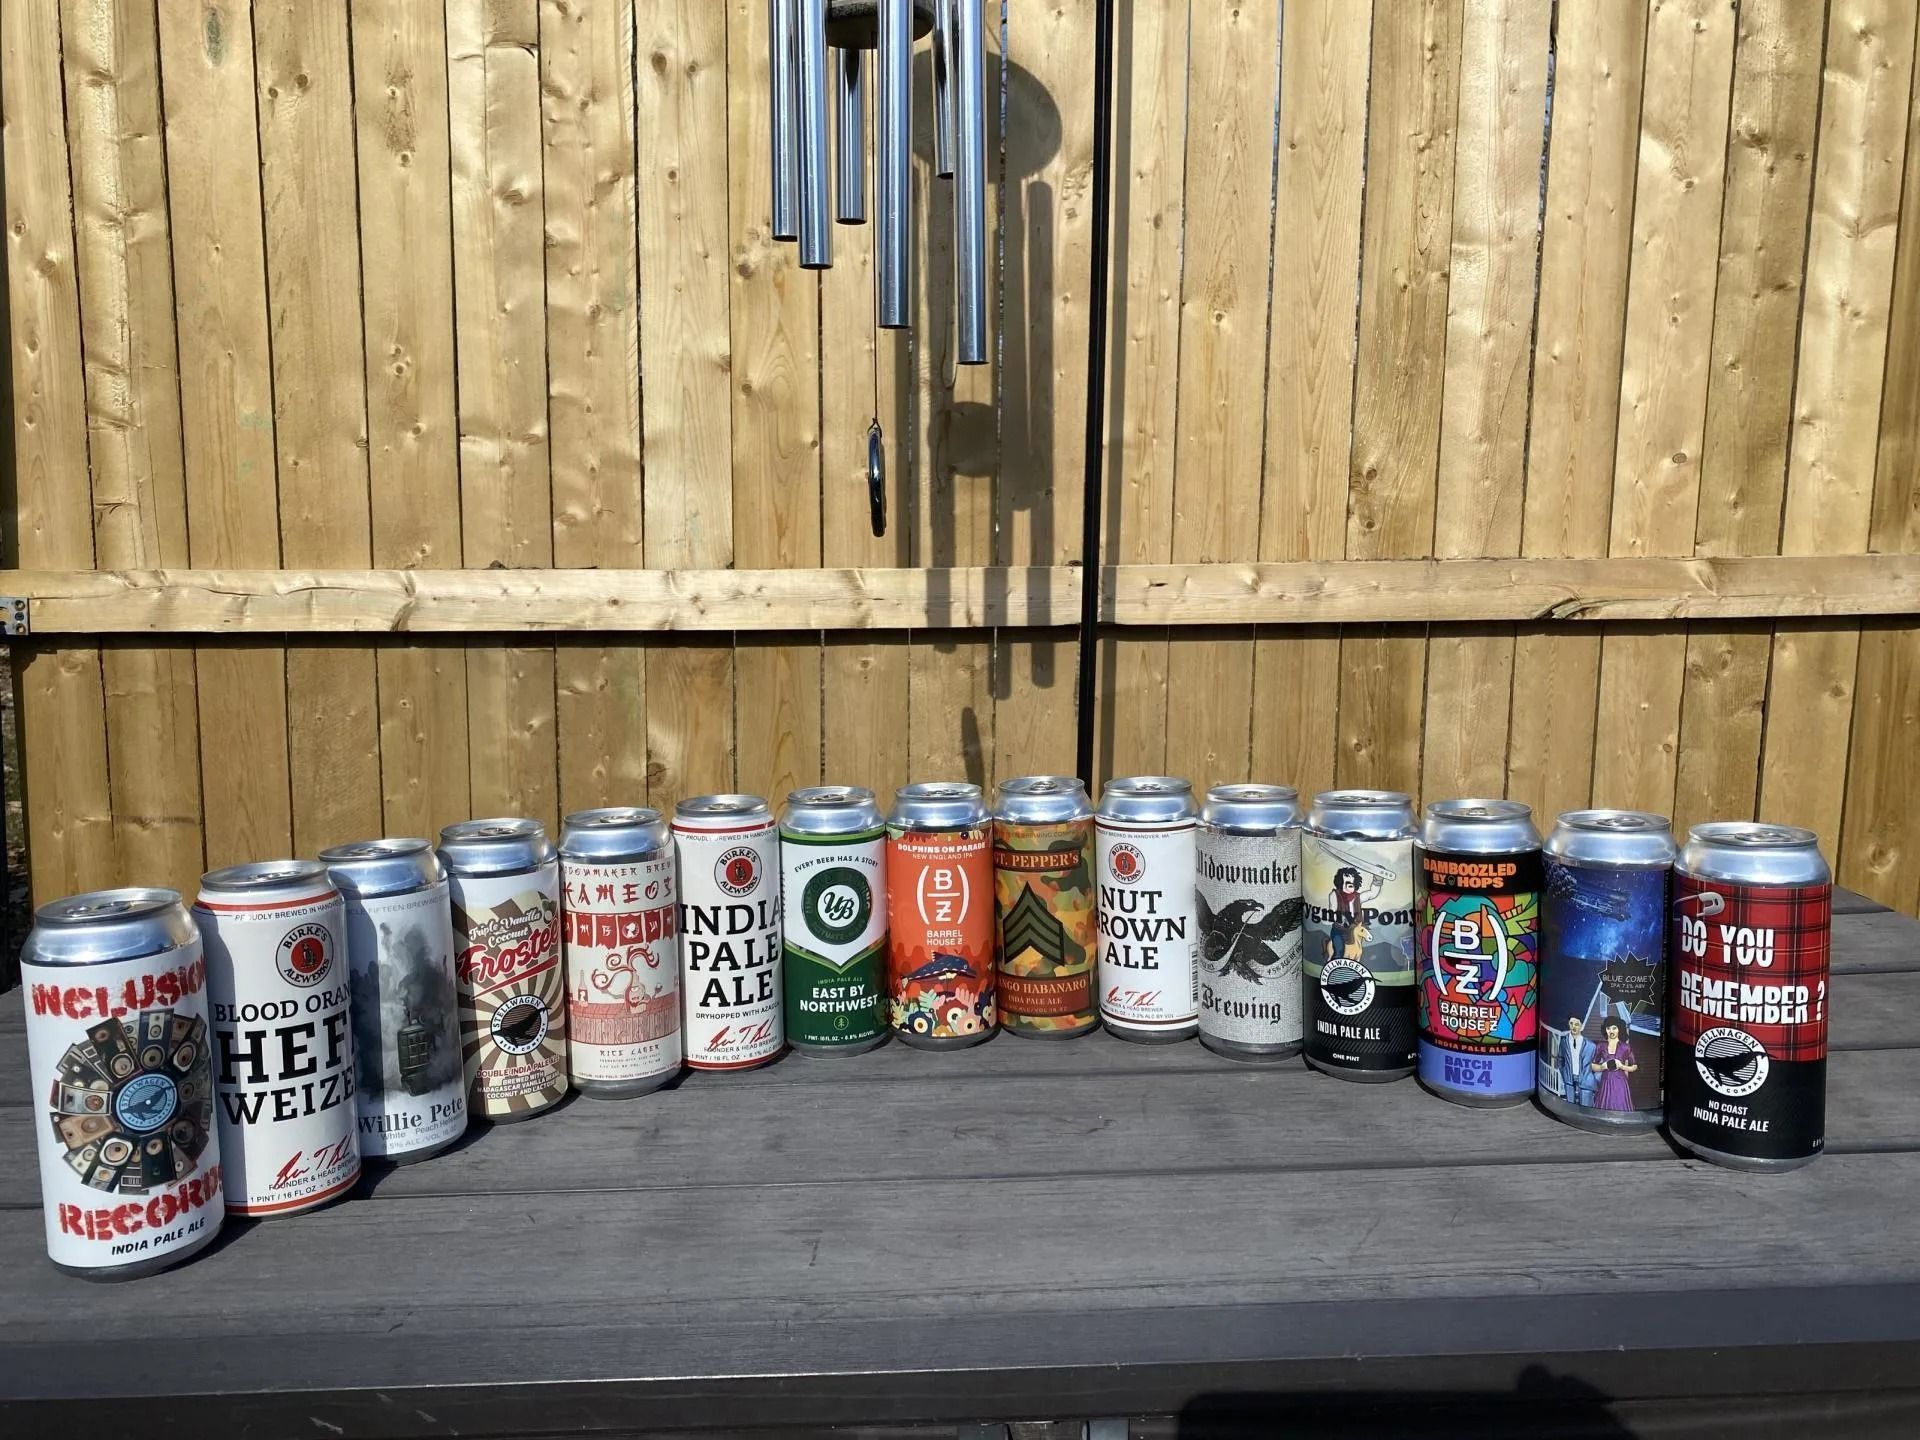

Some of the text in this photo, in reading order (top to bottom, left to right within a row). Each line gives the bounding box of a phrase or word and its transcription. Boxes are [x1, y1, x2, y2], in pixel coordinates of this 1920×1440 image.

[897, 843, 940, 854] DOLPHINS
[957, 842, 986, 852] PARADE
[1112, 844, 1140, 859] BURKE'S
[719, 849, 757, 866] BURKE'S
[794, 860, 814, 872] EVERY
[816, 856, 835, 865] BEER
[1423, 858, 1517, 877] BAMBOOZLED
[720, 875, 758, 894] ALEWERKS
[1433, 873, 1504, 888] BY HOPS
[1101, 884, 1162, 914] NUT
[275, 906, 316, 918] BREWED IN
[680, 894, 781, 935] INDIA
[468, 907, 542, 940] Triple Vanilla
[282, 926, 328, 950] BURKE'S
[488, 927, 529, 948] Coconut
[927, 930, 963, 938] BARREL
[927, 938, 956, 946] HOUSE
[1681, 915, 1774, 967] DO YOU
[688, 931, 779, 971] PALE
[1105, 942, 1159, 970] ALE
[284, 958, 330, 983] ALEWERKS
[1321, 960, 1366, 983] STELLWAGEN
[1602, 974, 1653, 983] BLUE COMET
[699, 969, 773, 1008] ALE
[812, 984, 865, 999] EAST BY
[1023, 978, 1086, 994] HABANARO
[800, 994, 878, 1013] NORTHWEST
[1026, 997, 1045, 1005] PALE
[1202, 983, 1281, 1026] Brewing
[1326, 992, 1372, 1013] BEER COMPANY
[1680, 970, 1809, 1024] REMEMBER
[214, 1000, 298, 1023] BLOOD
[493, 997, 541, 1028] STELLWAGEN
[695, 1008, 760, 1020] DRYHOPPED WITH
[1441, 1002, 1498, 1018] BARREL
[1317, 1020, 1381, 1040] INDIA PALE ALE
[1441, 1015, 1485, 1031] HOUSE
[631, 1044, 659, 1055] LAGER
[1434, 1039, 1458, 1050] INDIA
[1461, 1043, 1486, 1053] PALE
[1697, 1028, 1759, 1055] STELLWAGEN
[476, 1060, 549, 1078] DOUBLE INDIA PALE
[1444, 1055, 1493, 1070] BATCH
[522, 1077, 546, 1088] VANILLA
[1702, 1069, 1764, 1094] BEER COMPANY
[486, 1091, 518, 1099] COCONUT
[358, 1112, 422, 1134] Willie
[430, 1097, 463, 1123] Pete
[1708, 1099, 1748, 1116] NO COAST
[1693, 1107, 1770, 1132] INDIA PALE ALE
[380, 1124, 438, 1141] White Peach
[318, 1167, 336, 1178] HEAD
[256, 1195, 276, 1203] PINT
[283, 1191, 292, 1199] 16
[294, 1188, 303, 1196] FL
[305, 1185, 317, 1193] OZ
[111, 1217, 205, 1255] INDIA PALE ALE
